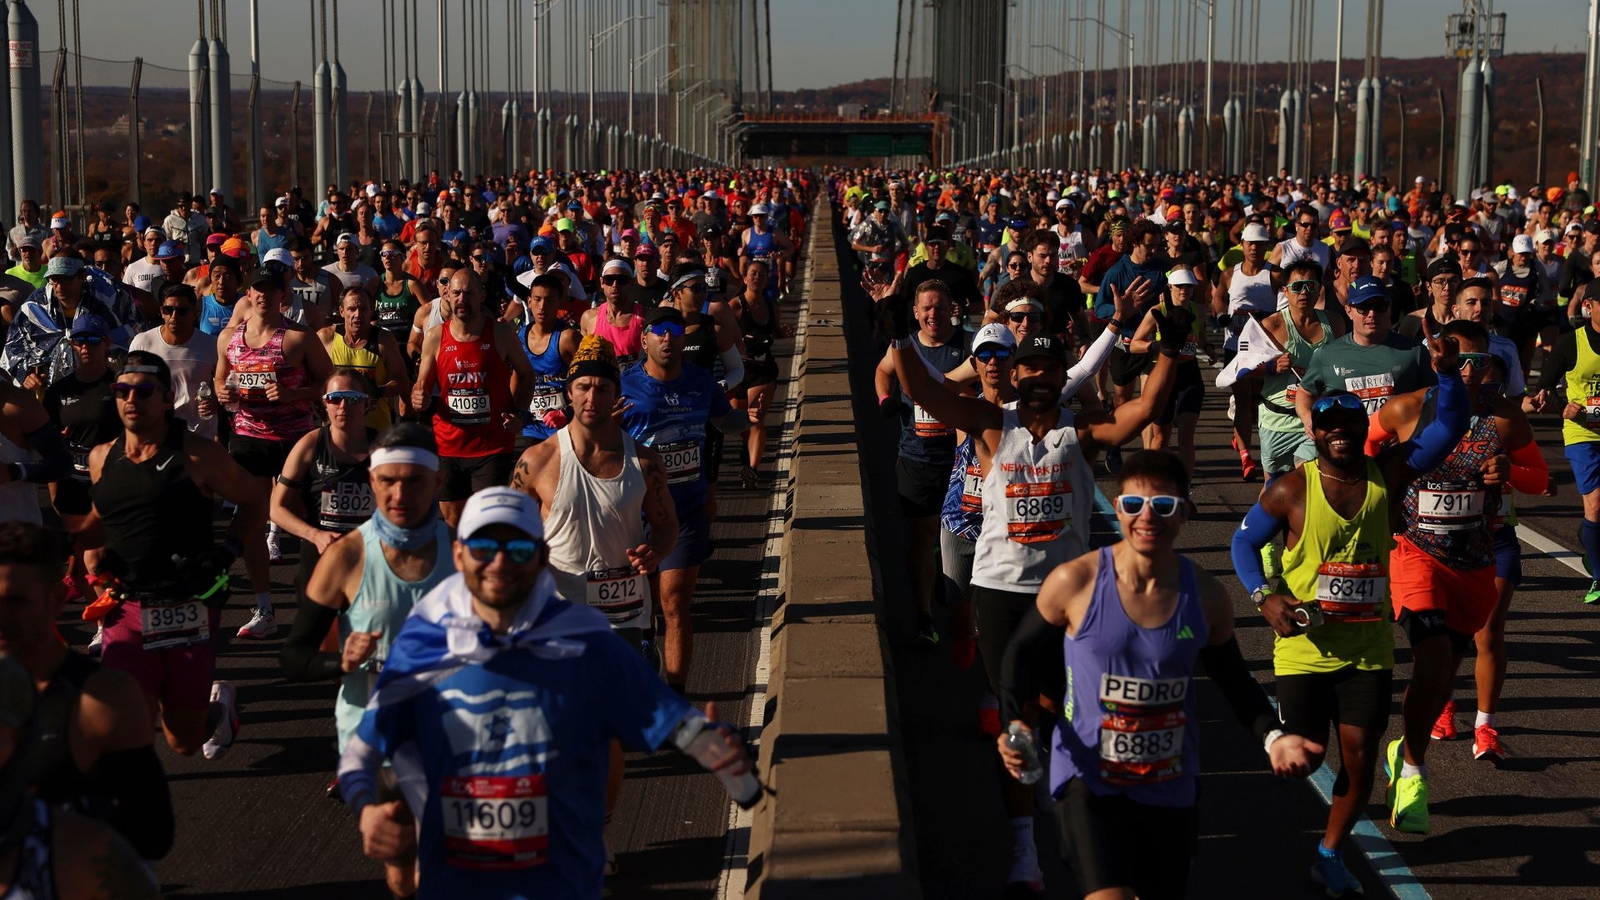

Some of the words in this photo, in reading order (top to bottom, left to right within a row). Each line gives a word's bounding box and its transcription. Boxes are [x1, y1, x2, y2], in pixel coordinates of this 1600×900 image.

[447, 371, 488, 384] FDNY
[452, 397, 487, 410] 41089
[533, 395, 558, 409] 5677
[659, 448, 699, 468] 8004
[1000, 463, 1025, 473] NEW
[1427, 481, 1441, 491] tcs
[330, 495, 371, 511] 5802
[1016, 496, 1064, 517] 6869
[1432, 494, 1471, 511] 7911
[1327, 564, 1343, 574] tcs
[599, 579, 636, 600] 6212
[1329, 578, 1374, 597] 6341
[151, 604, 198, 627] 3953
[1104, 678, 1186, 702] PEDRO
[1115, 731, 1174, 755] 6883
[451, 801, 536, 829] 11609
